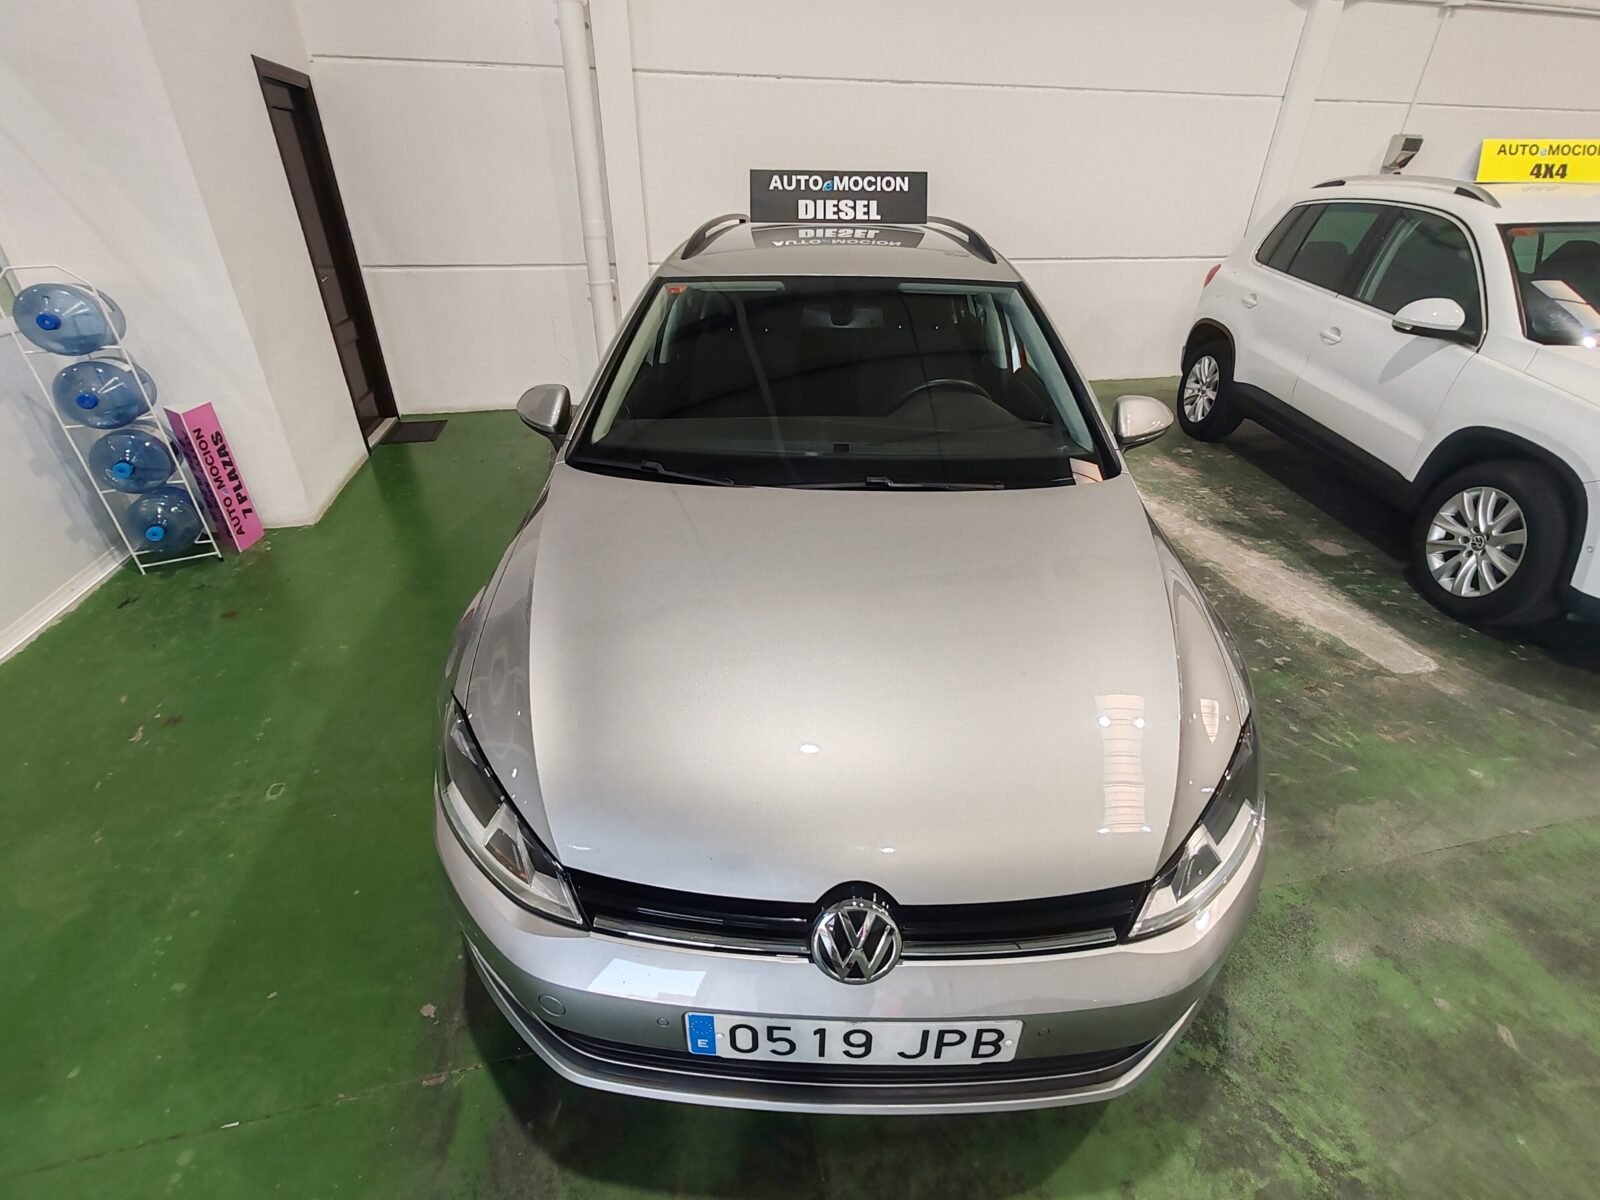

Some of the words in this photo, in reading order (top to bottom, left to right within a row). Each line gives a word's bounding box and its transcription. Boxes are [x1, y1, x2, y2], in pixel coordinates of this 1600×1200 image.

[1497, 144, 1600, 156] AUTOeMOCIO
[1530, 163, 1568, 179] 4X4
[798, 199, 881, 220] DIESEL
[211, 430, 249, 505] PLAZAS
[242, 508, 254, 519] 7
[697, 1038, 709, 1048] E
[728, 1023, 874, 1059] 0519
[897, 1028, 1006, 1060] JPB
